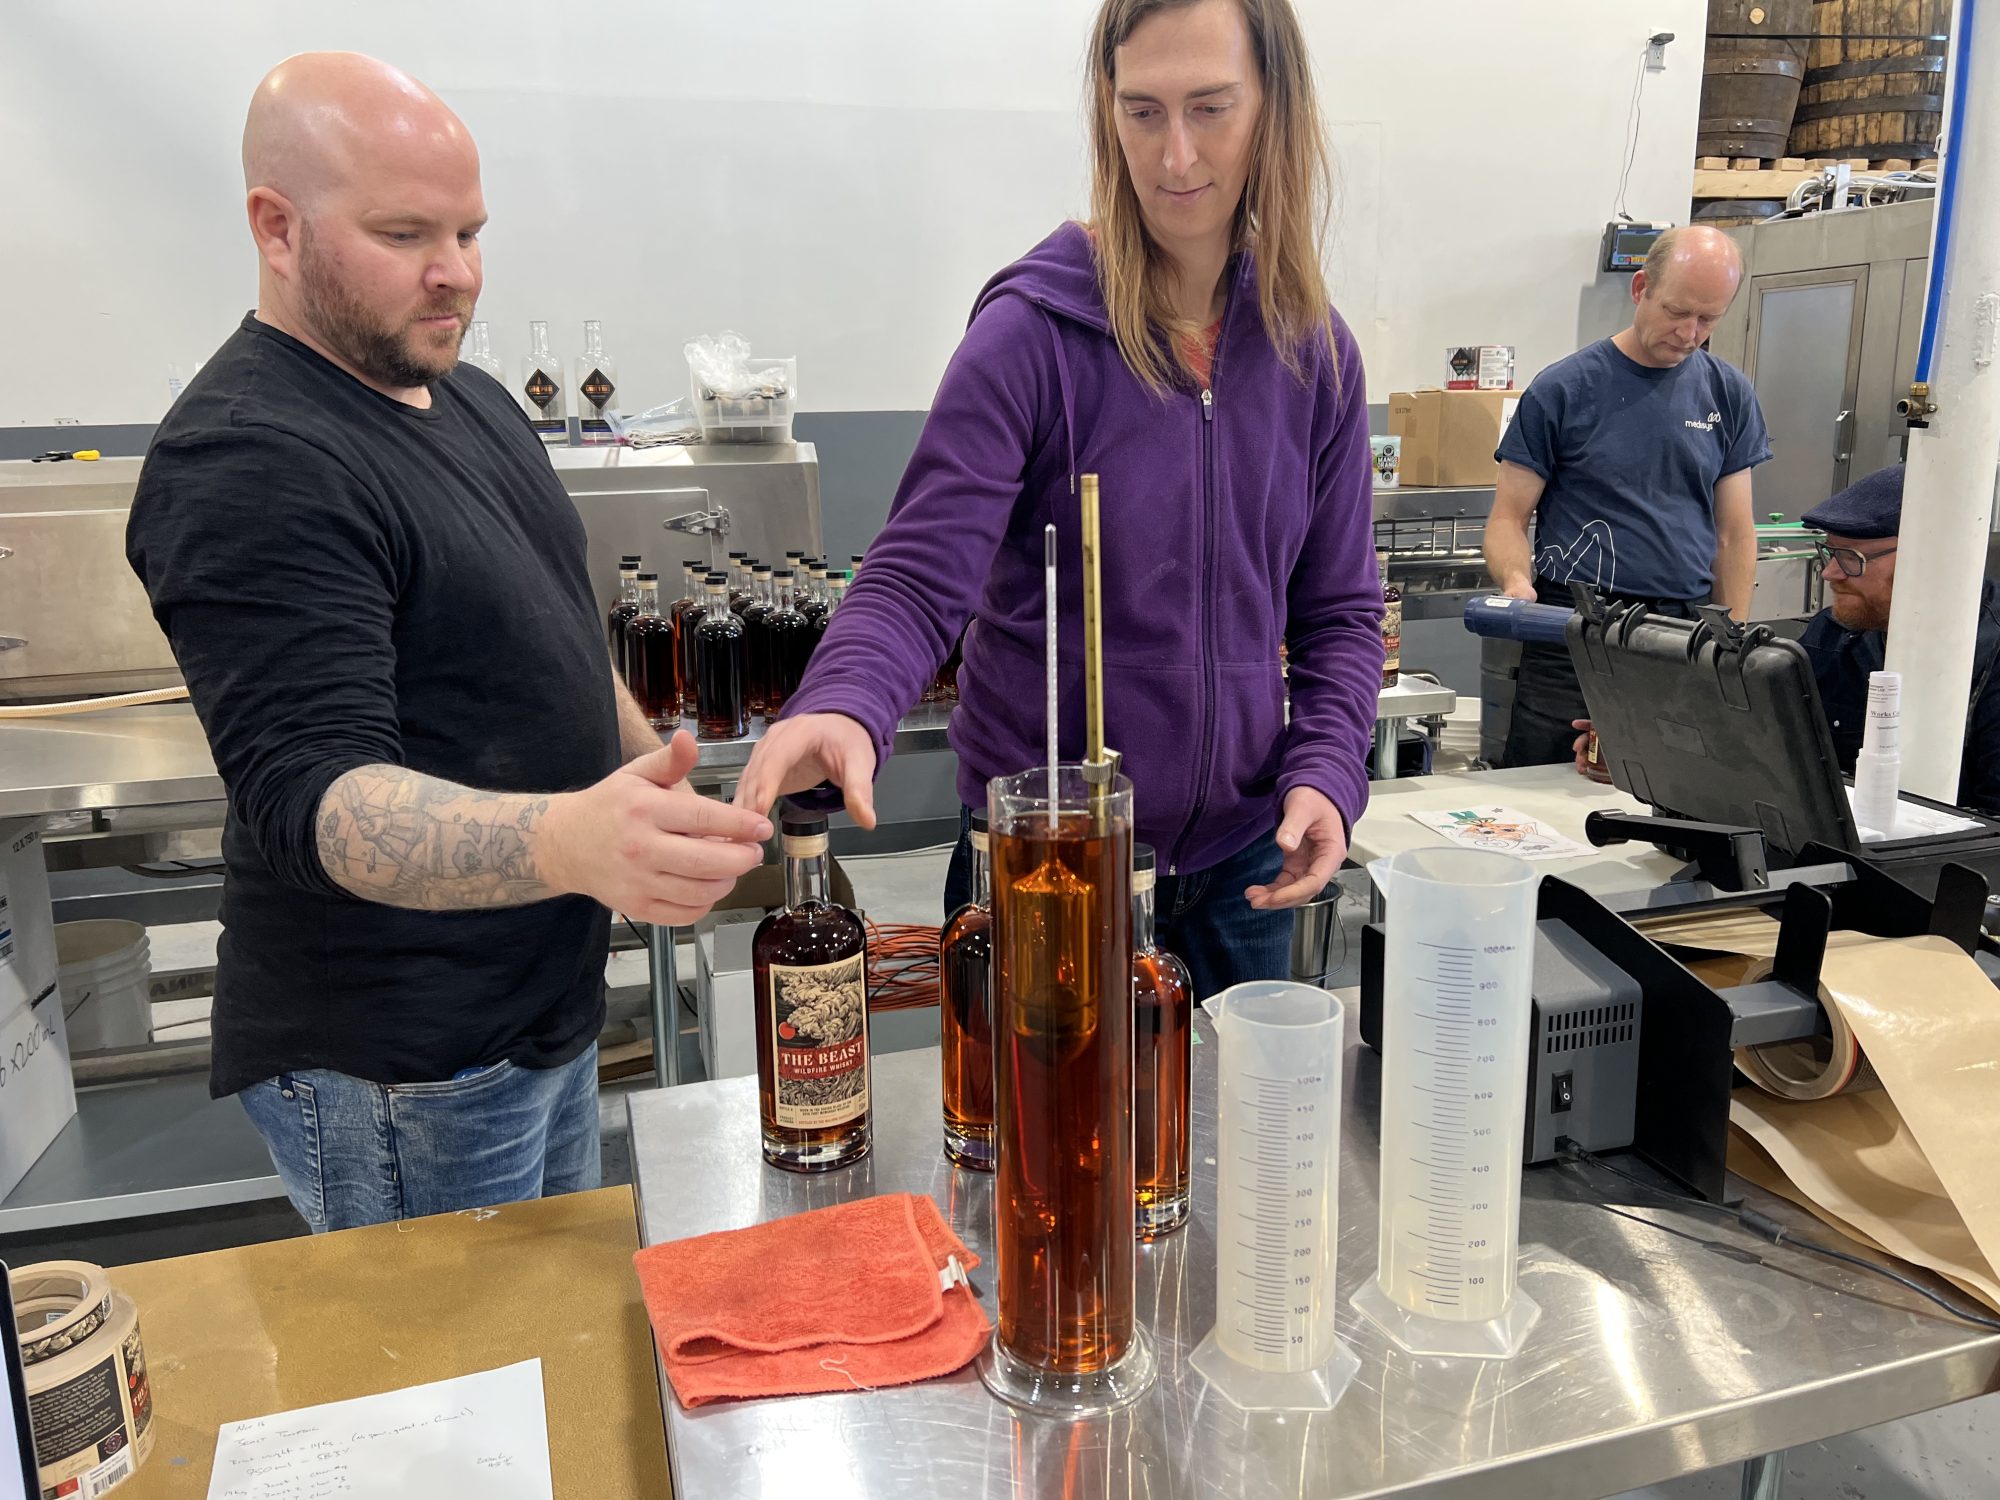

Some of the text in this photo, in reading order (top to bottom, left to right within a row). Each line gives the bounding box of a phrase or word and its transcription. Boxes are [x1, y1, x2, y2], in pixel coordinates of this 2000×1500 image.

[1870, 709, 1892, 718] Works
[1479, 981, 1498, 990] 900
[1477, 1018, 1497, 1026] 800
[781, 1041, 863, 1066] THE BEAST
[1477, 1055, 1495, 1063] 700
[794, 1059, 853, 1075] WILDFIRE WHISKY
[1474, 1091, 1493, 1100] 600
[1472, 1127, 1491, 1136] 500
[1295, 1159, 1313, 1170] 350
[1471, 1165, 1490, 1173] 400
[1295, 1188, 1312, 1198] 300
[1294, 1218, 1311, 1228] 250
[1468, 1239, 1486, 1248] 200
[1294, 1247, 1311, 1257] 200
[1295, 1275, 1310, 1286] 150
[1468, 1276, 1485, 1285] 100
[1294, 1305, 1310, 1315] 100
[1291, 1335, 1303, 1344] 50
